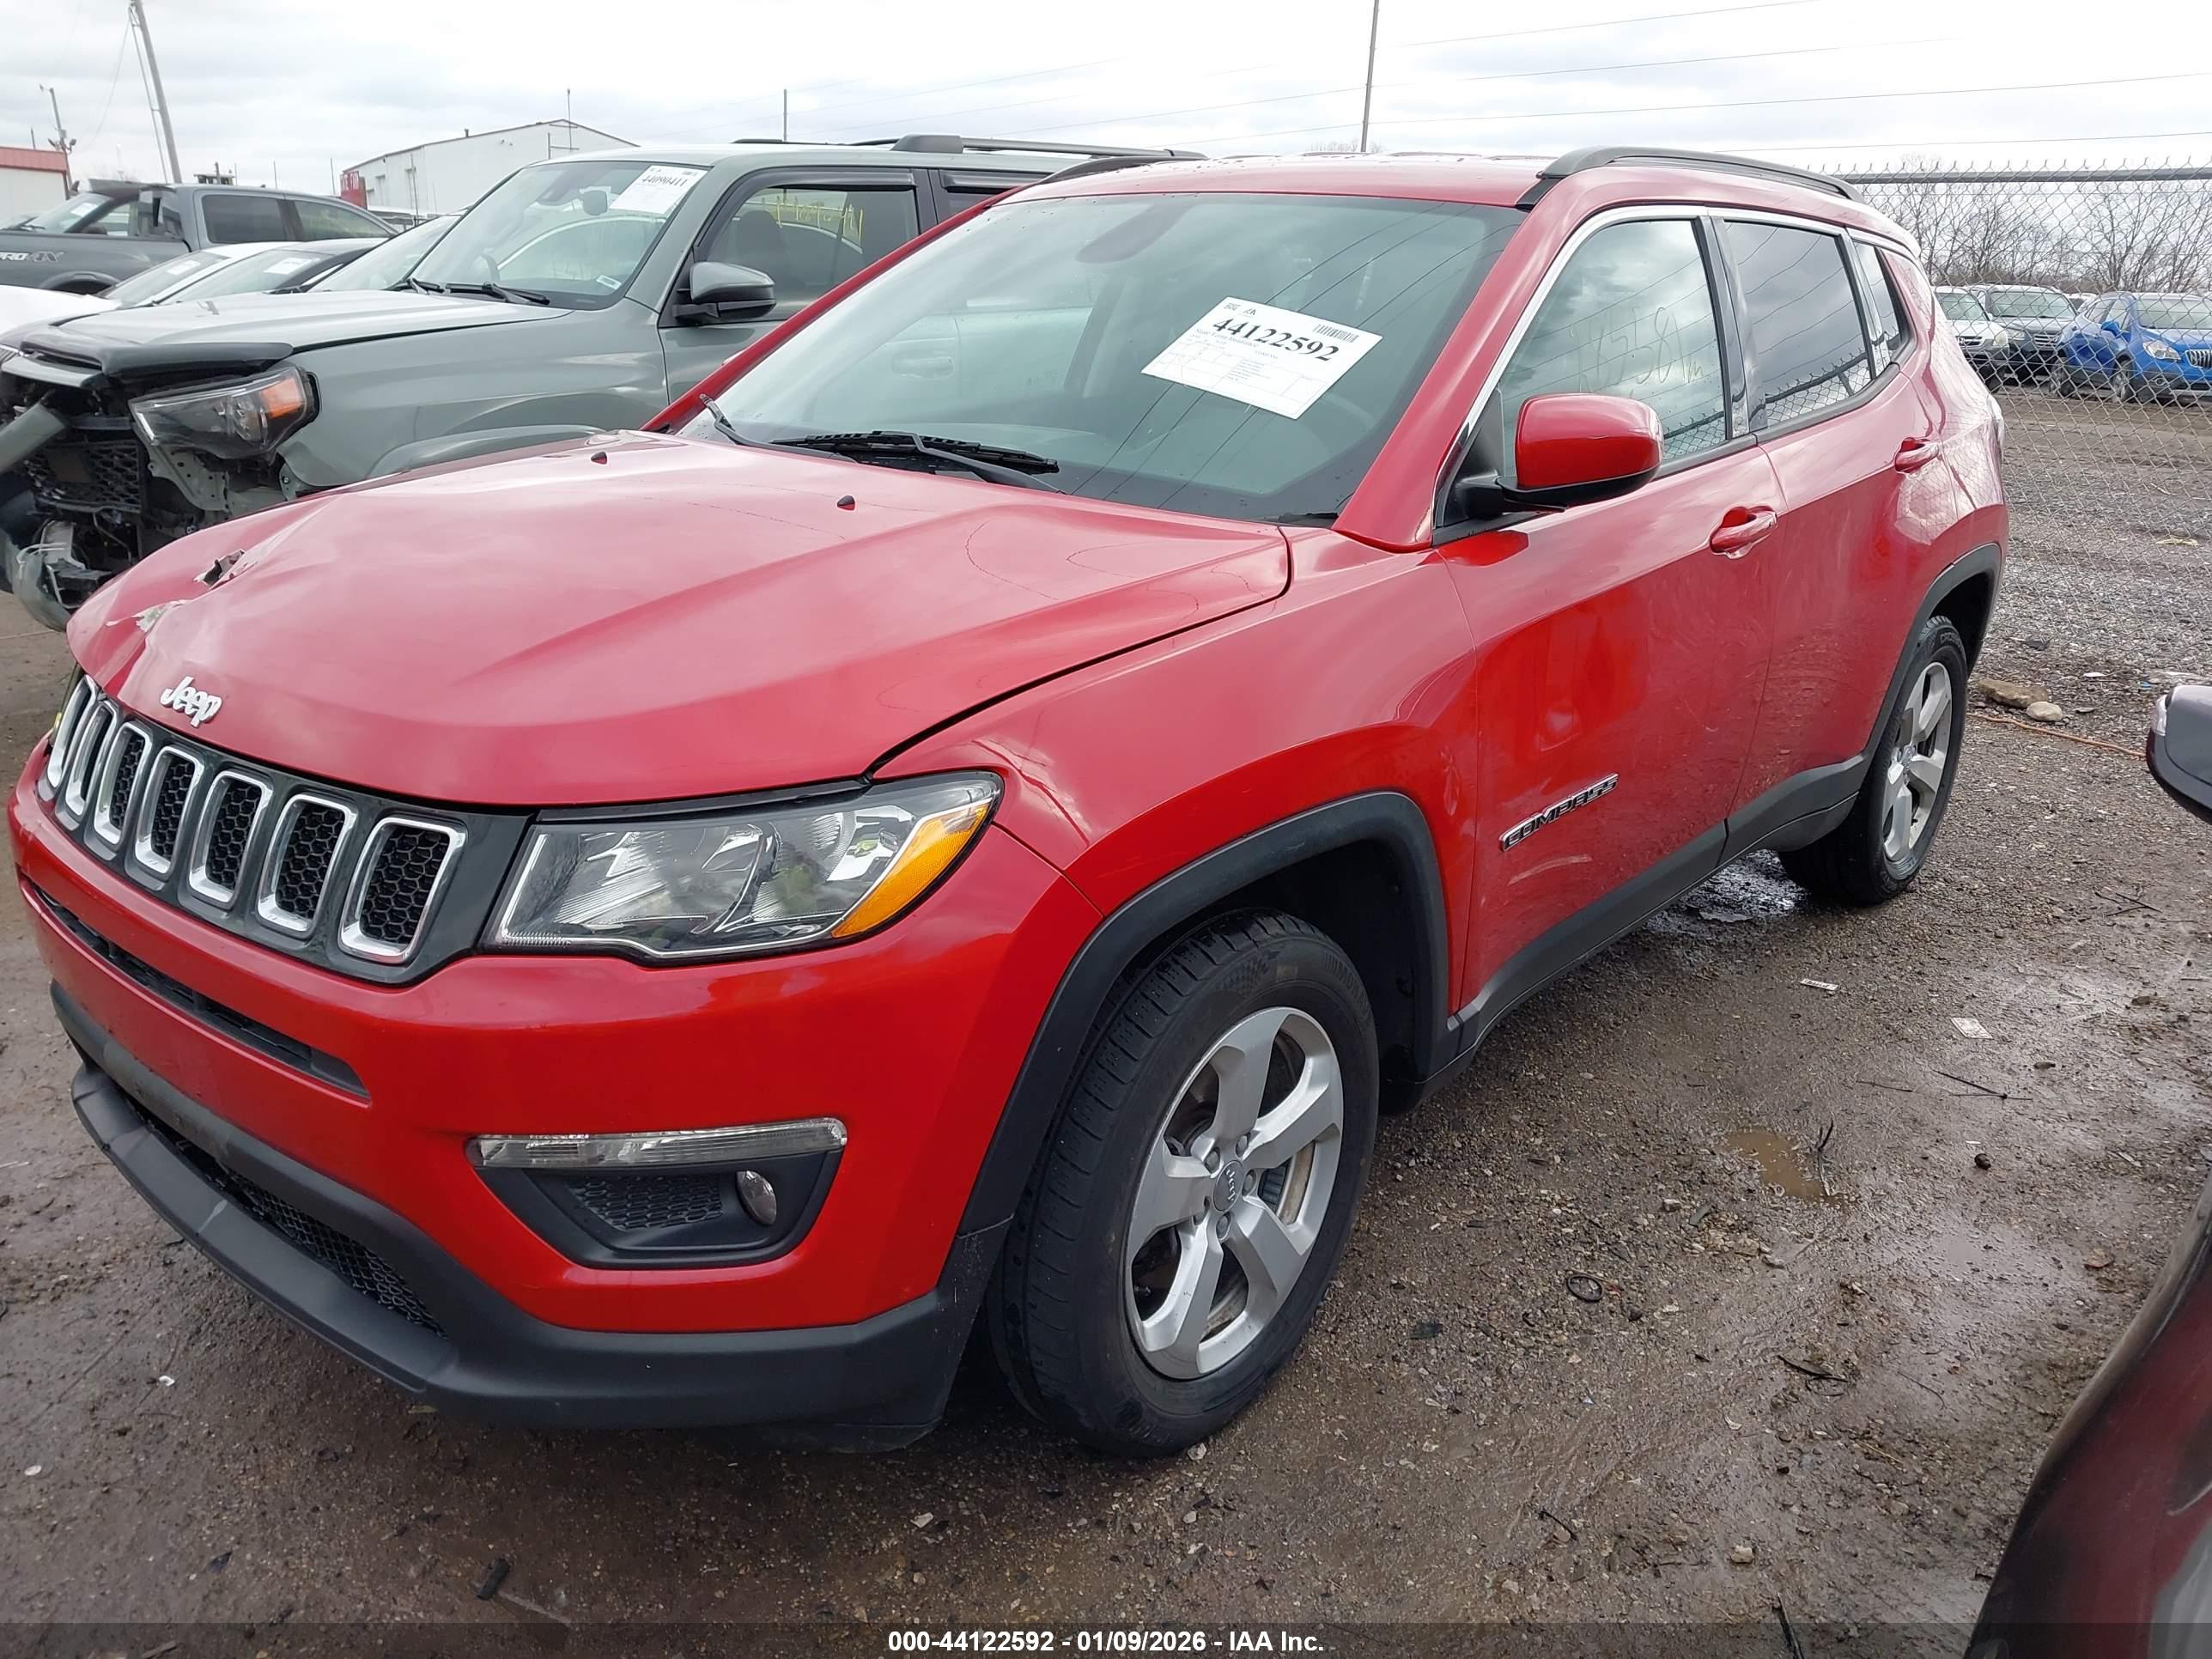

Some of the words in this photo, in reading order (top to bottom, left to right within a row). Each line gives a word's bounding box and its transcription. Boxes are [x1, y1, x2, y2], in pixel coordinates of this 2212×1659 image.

[1212, 317, 1340, 362] 44122592
[160, 675, 223, 728] Jeep
[1499, 772, 1620, 852] COMPASS
